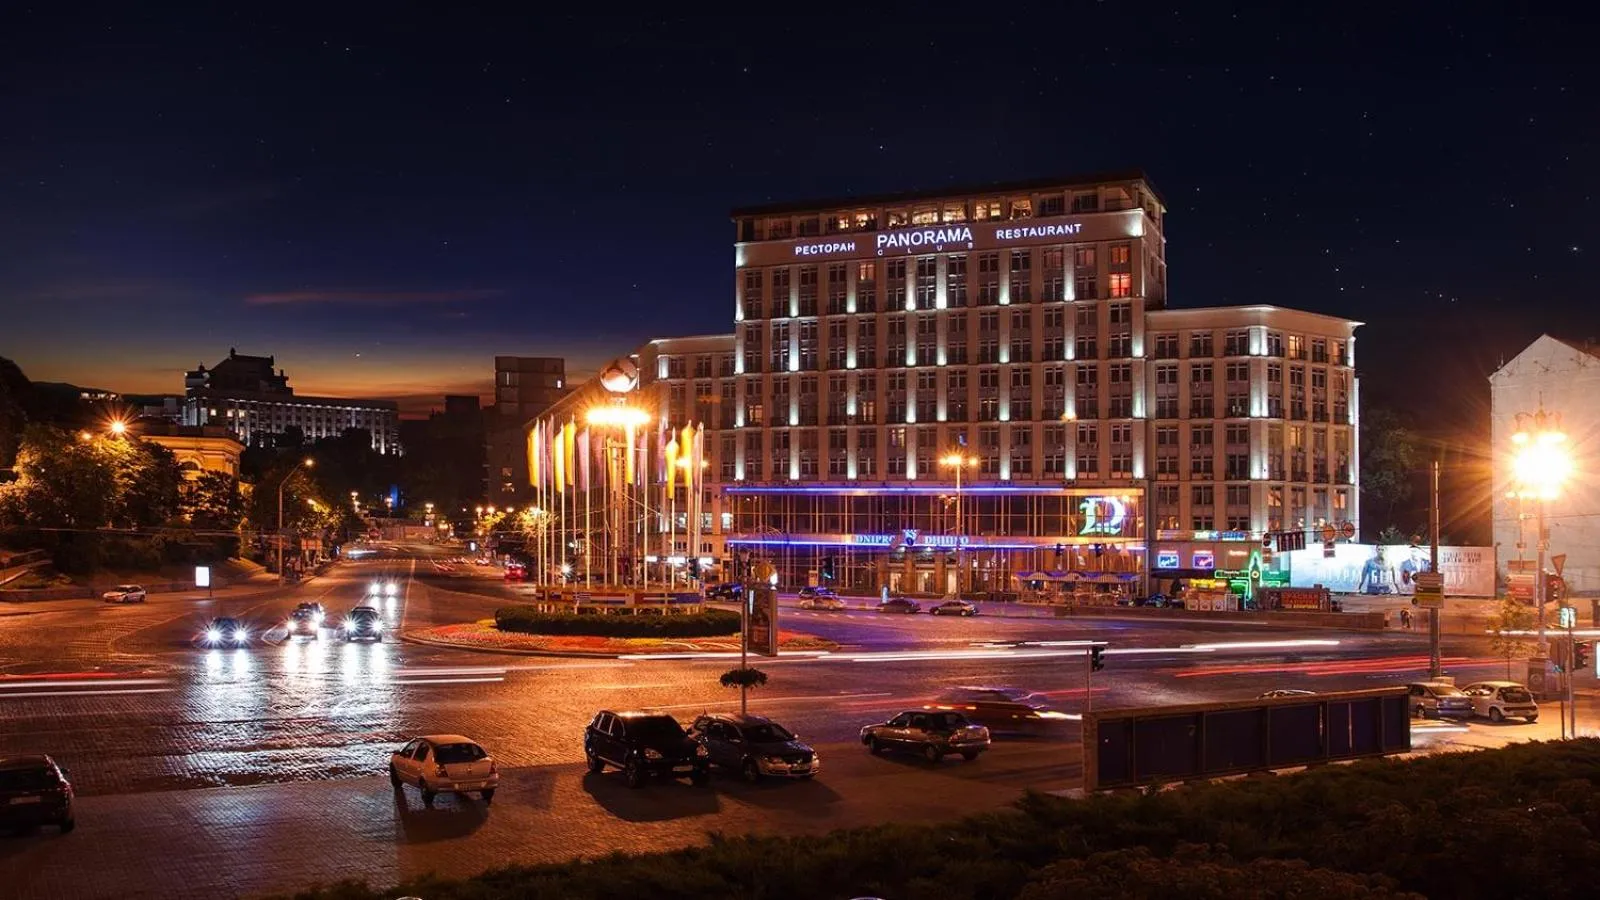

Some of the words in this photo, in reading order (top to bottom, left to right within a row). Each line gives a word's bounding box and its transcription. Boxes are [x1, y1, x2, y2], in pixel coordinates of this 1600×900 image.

[877, 227, 973, 248] PANORAMA
[996, 223, 1082, 239] RESTAURANT
[795, 242, 855, 255] РЕСТОРАН
